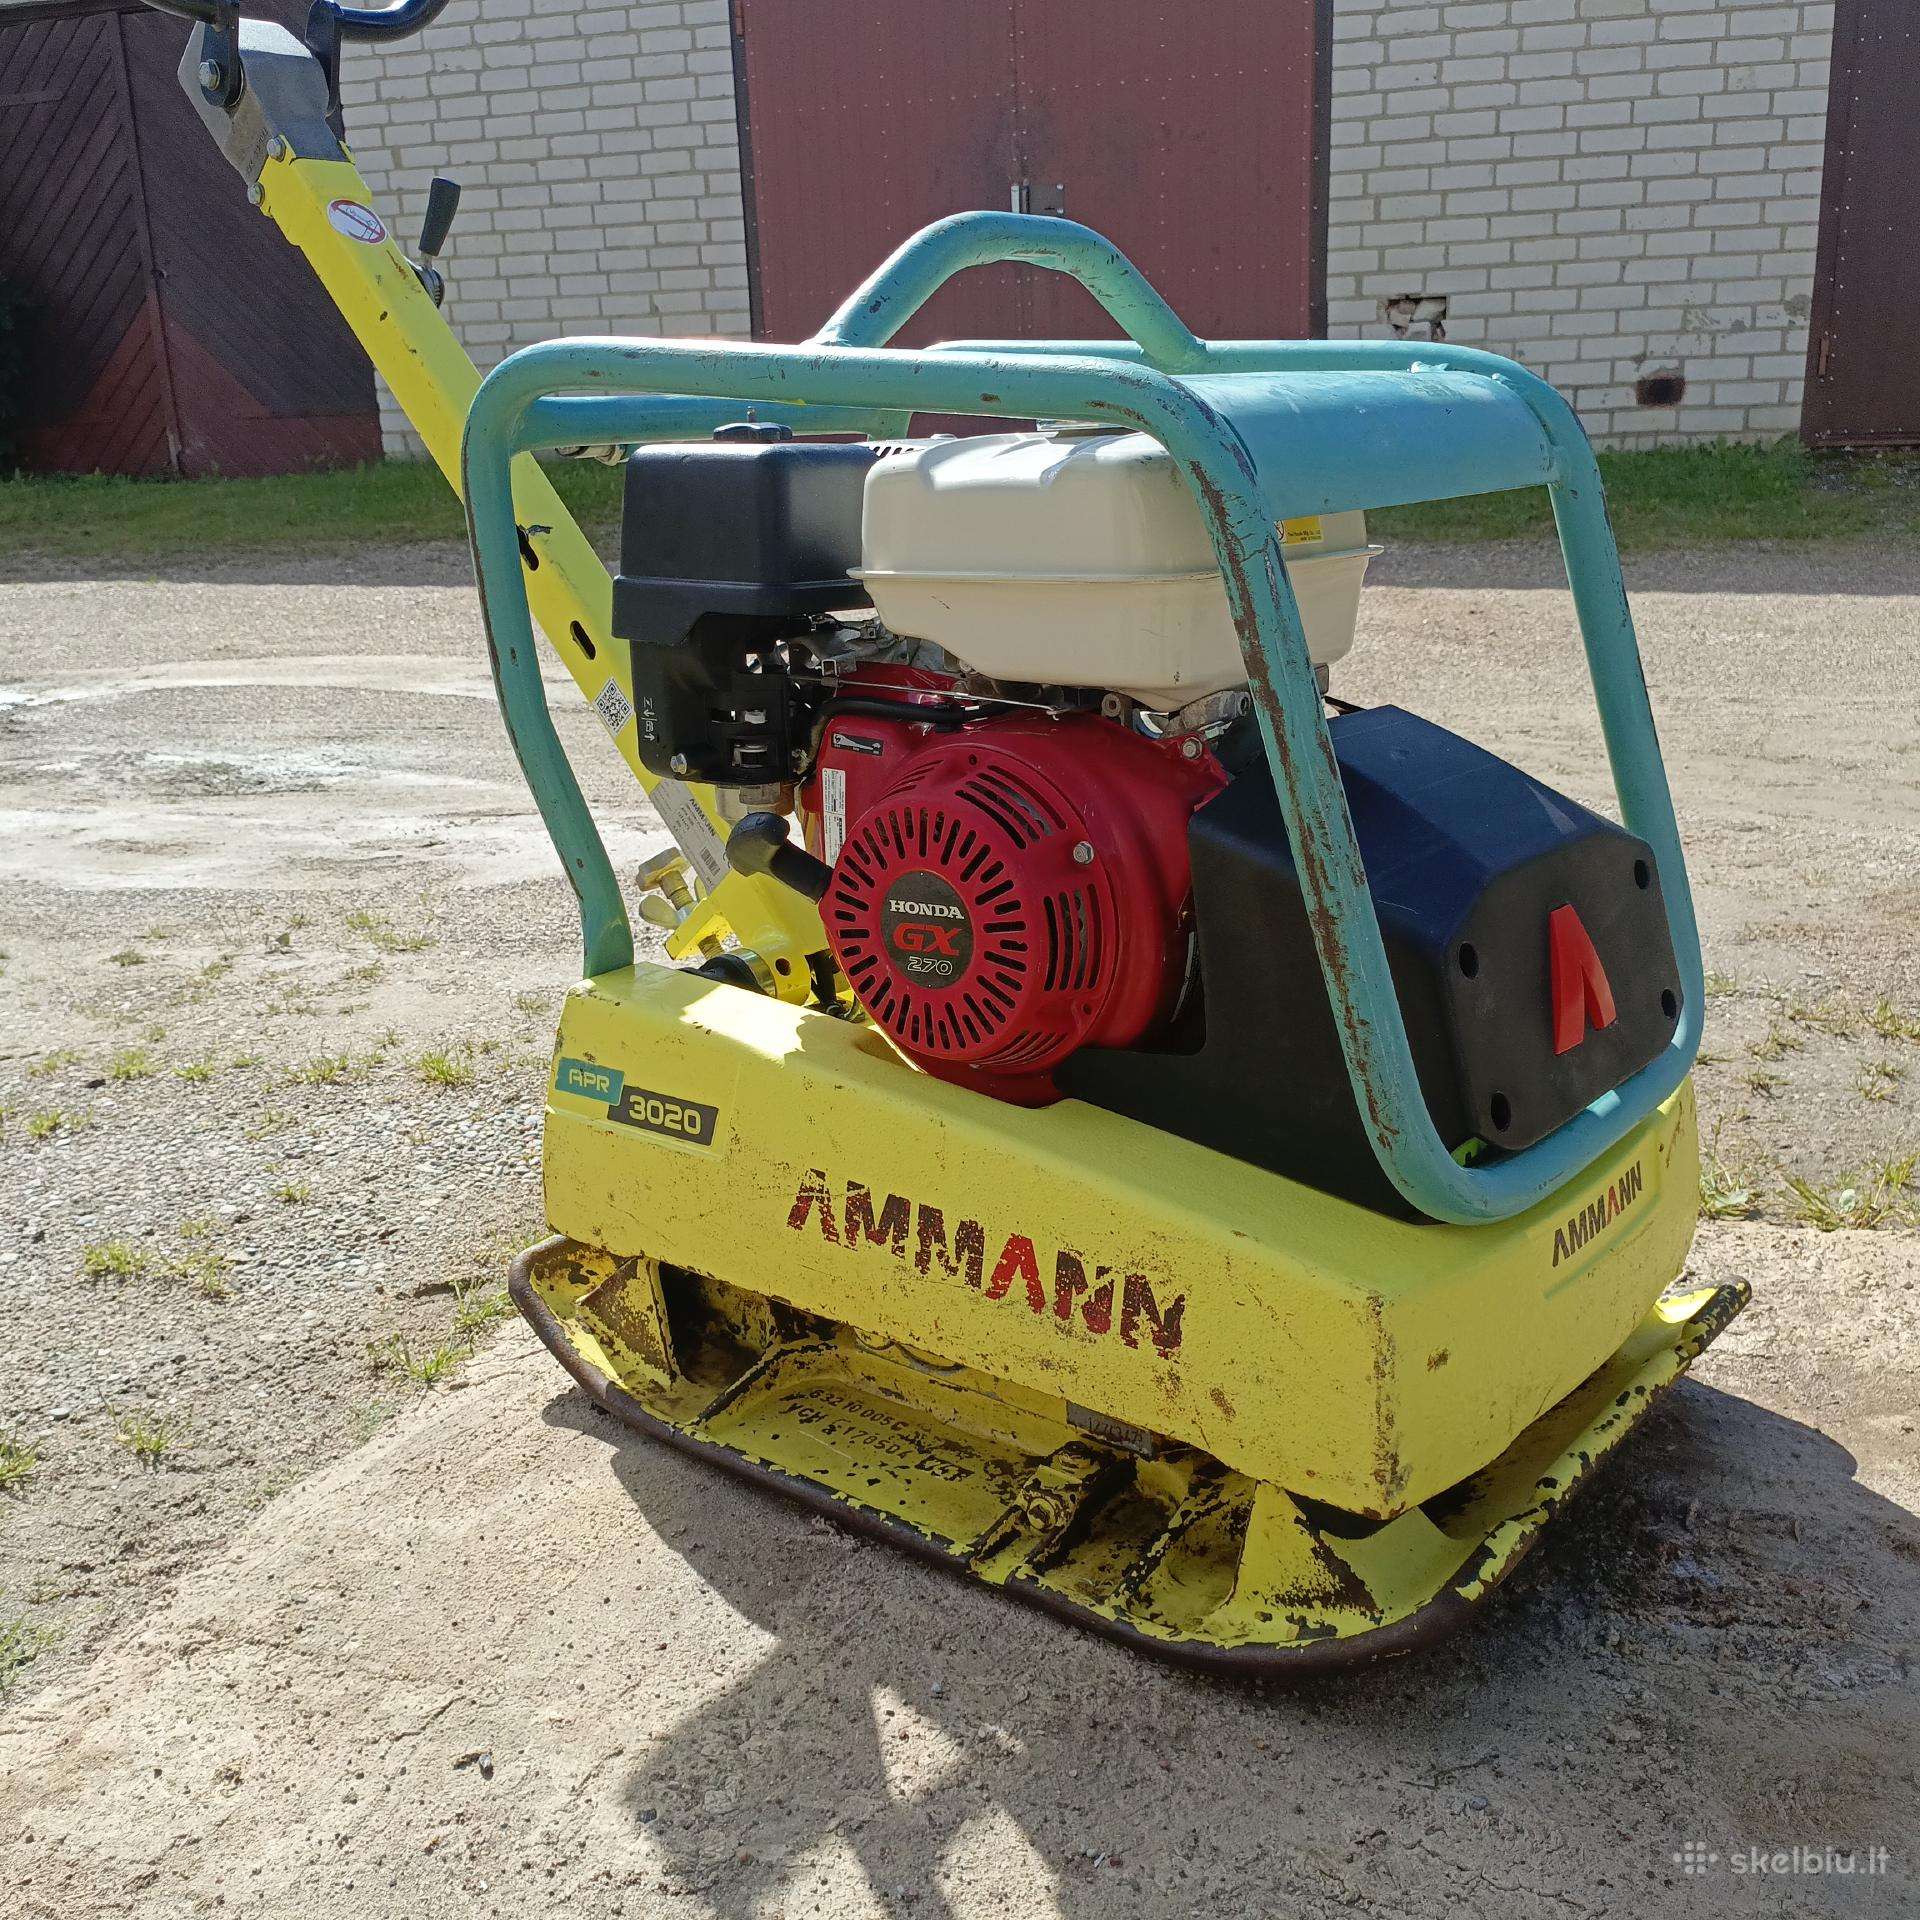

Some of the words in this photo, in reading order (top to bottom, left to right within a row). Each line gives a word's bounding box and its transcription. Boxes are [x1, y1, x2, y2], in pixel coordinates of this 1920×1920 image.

[889, 899, 965, 920] HONDA
[892, 922, 962, 956] GX
[907, 955, 953, 976] 270
[568, 1067, 610, 1094] APR
[628, 1094, 702, 1136] 3020
[1552, 1160, 1642, 1268] AMMANN
[786, 1168, 1186, 1360] AMMANN
